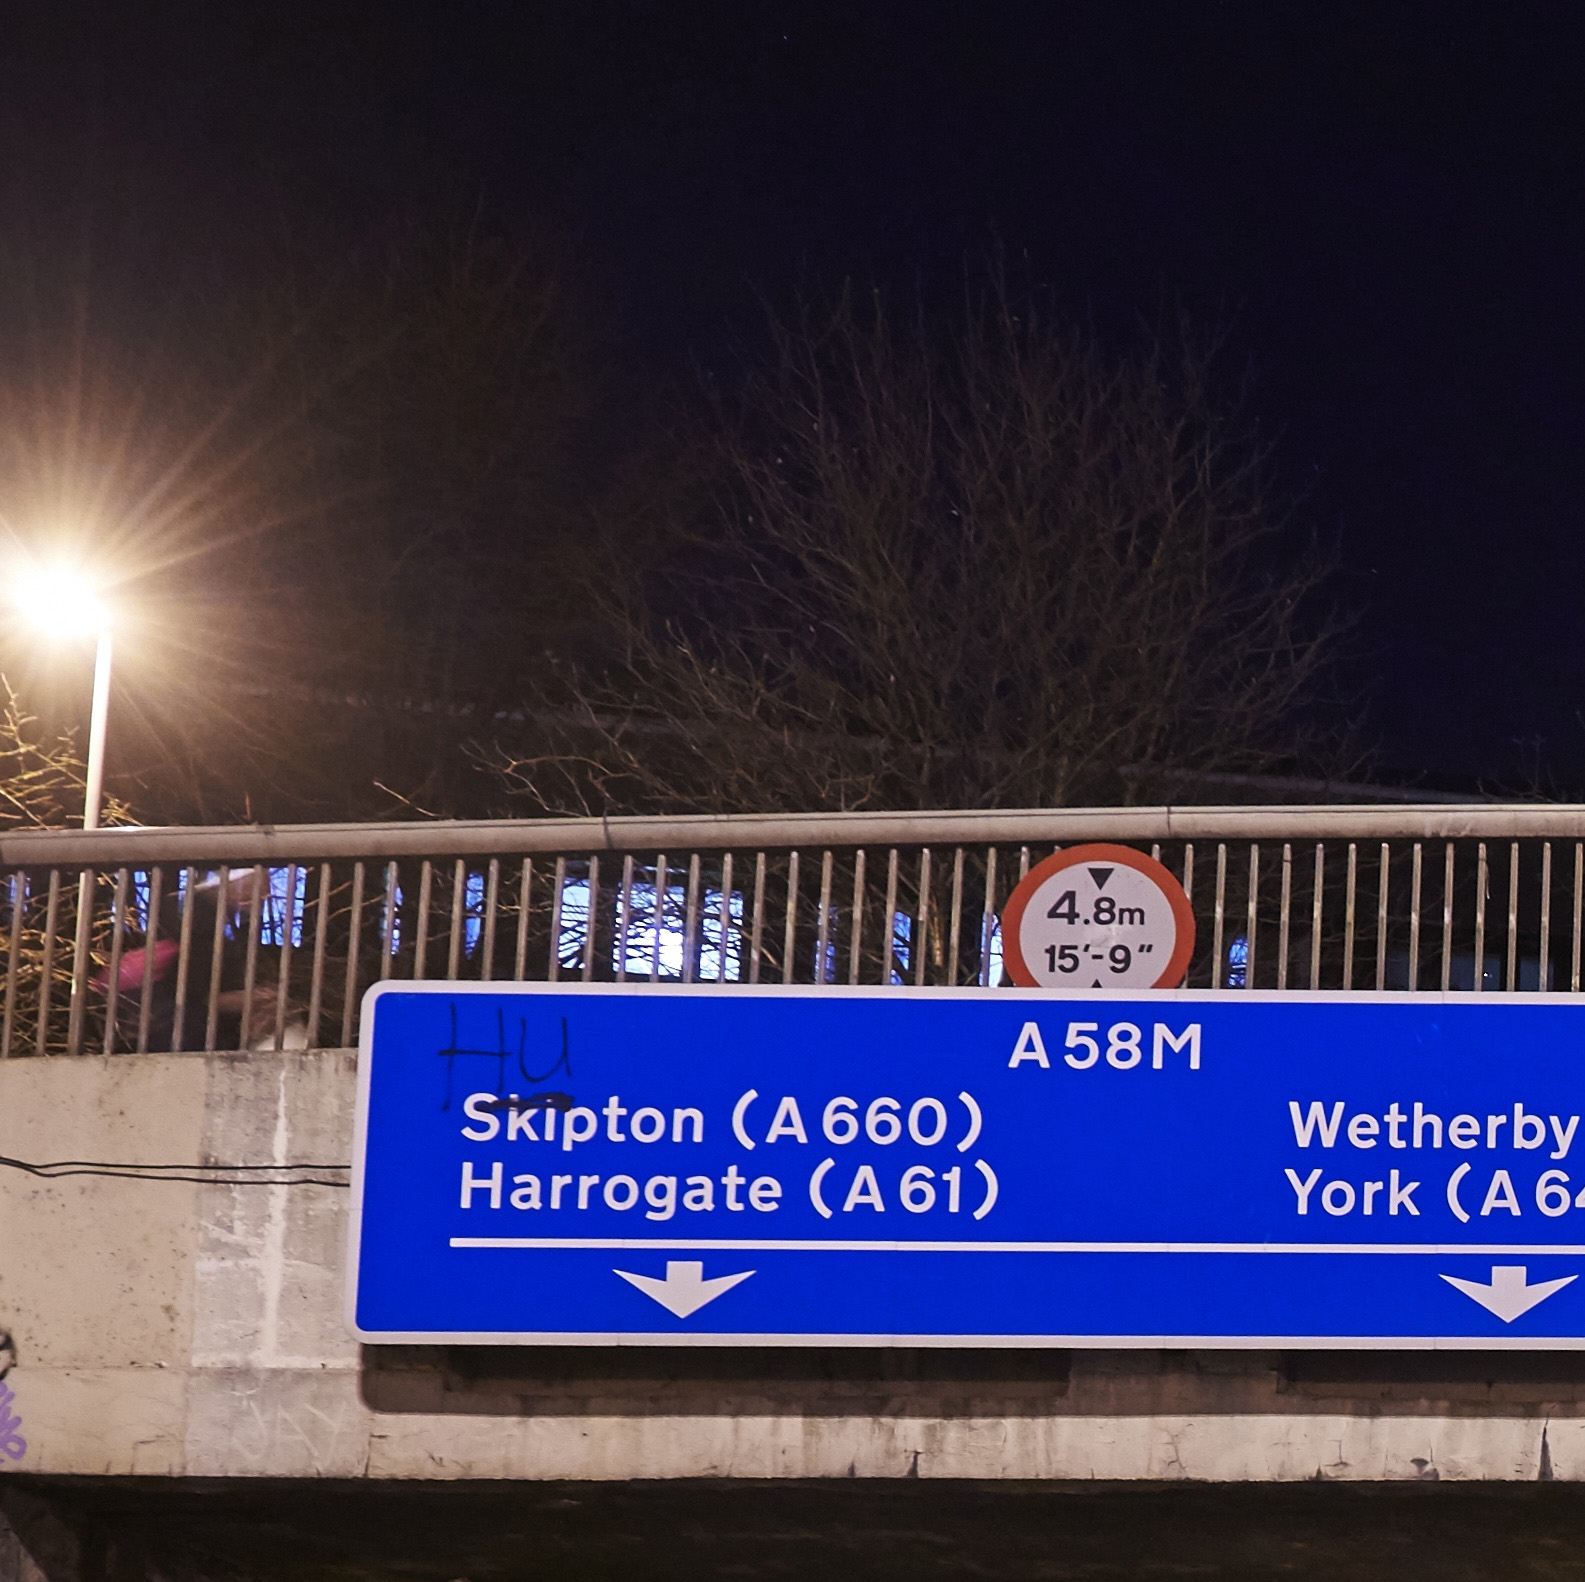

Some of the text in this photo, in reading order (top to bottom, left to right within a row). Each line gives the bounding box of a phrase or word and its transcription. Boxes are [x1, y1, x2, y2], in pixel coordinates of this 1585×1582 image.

[1046, 890, 1146, 926] 4.8m
[460, 1092, 704, 1152] Skipton
[1288, 1100, 1580, 1160] Wetherby
[460, 1161, 783, 1221] Harrogate
[1284, 1165, 1421, 1217] York
